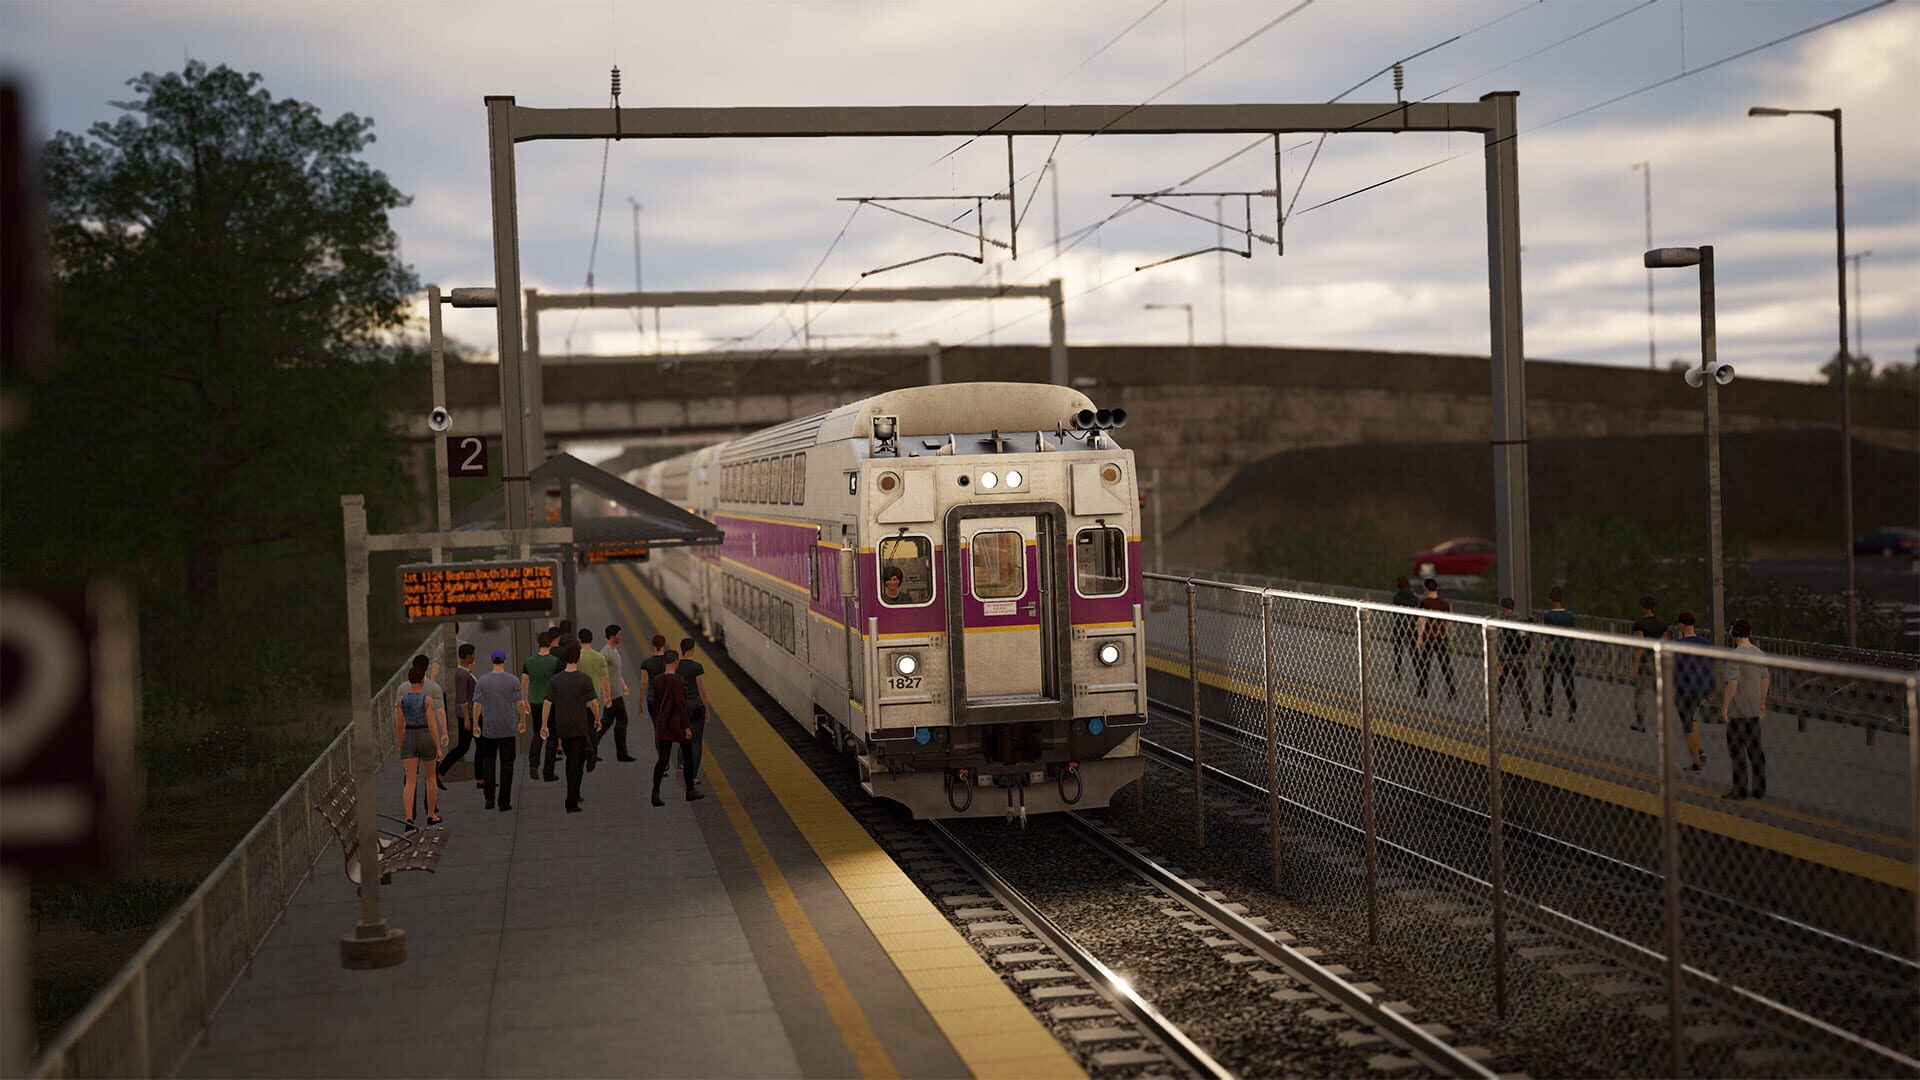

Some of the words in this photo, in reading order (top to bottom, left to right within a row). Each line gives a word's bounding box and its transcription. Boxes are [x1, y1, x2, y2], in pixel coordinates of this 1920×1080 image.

[461, 437, 483, 471] 2
[446, 570, 476, 581] Boston
[535, 566, 552, 576] TIME
[447, 592, 476, 603] Boston
[535, 588, 553, 599] TIME
[888, 677, 922, 690] 1827
